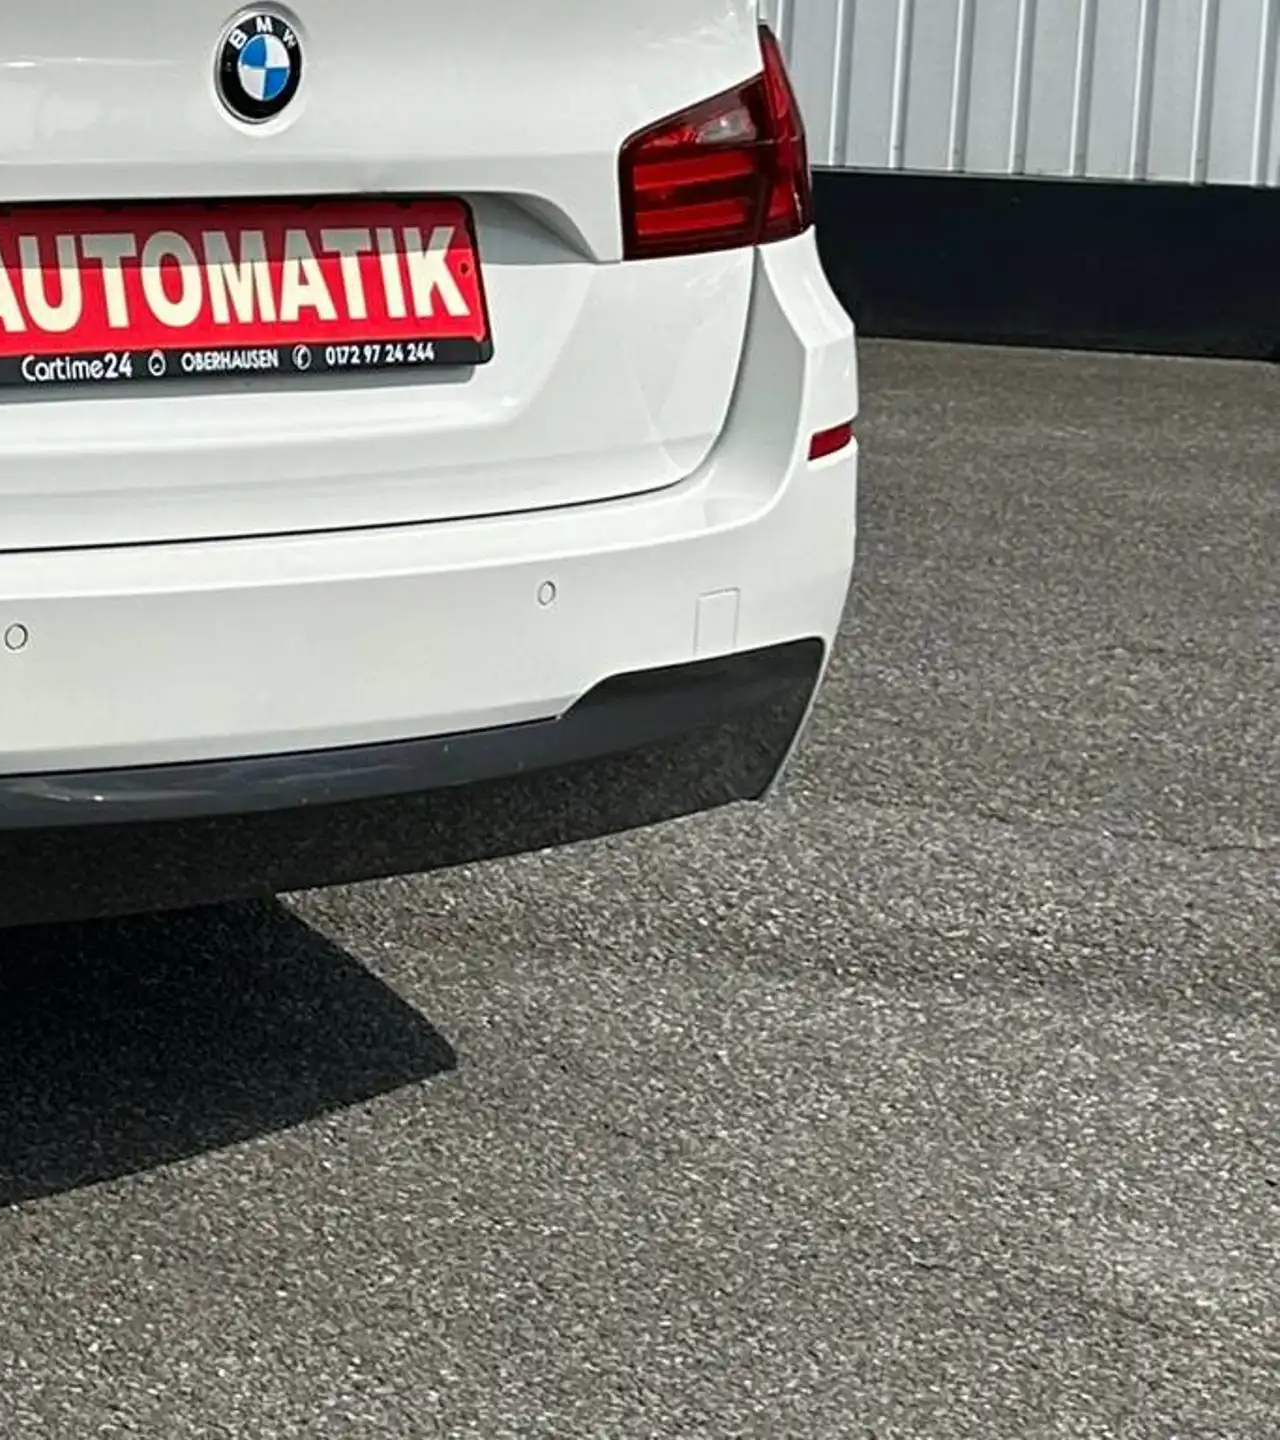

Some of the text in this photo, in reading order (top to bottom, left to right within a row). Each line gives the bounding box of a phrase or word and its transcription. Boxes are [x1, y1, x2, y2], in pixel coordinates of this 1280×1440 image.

[228, 16, 297, 50] BMW
[21, 342, 435, 381] Cartime24 OBERHAUSEN 0172 97 24 244
